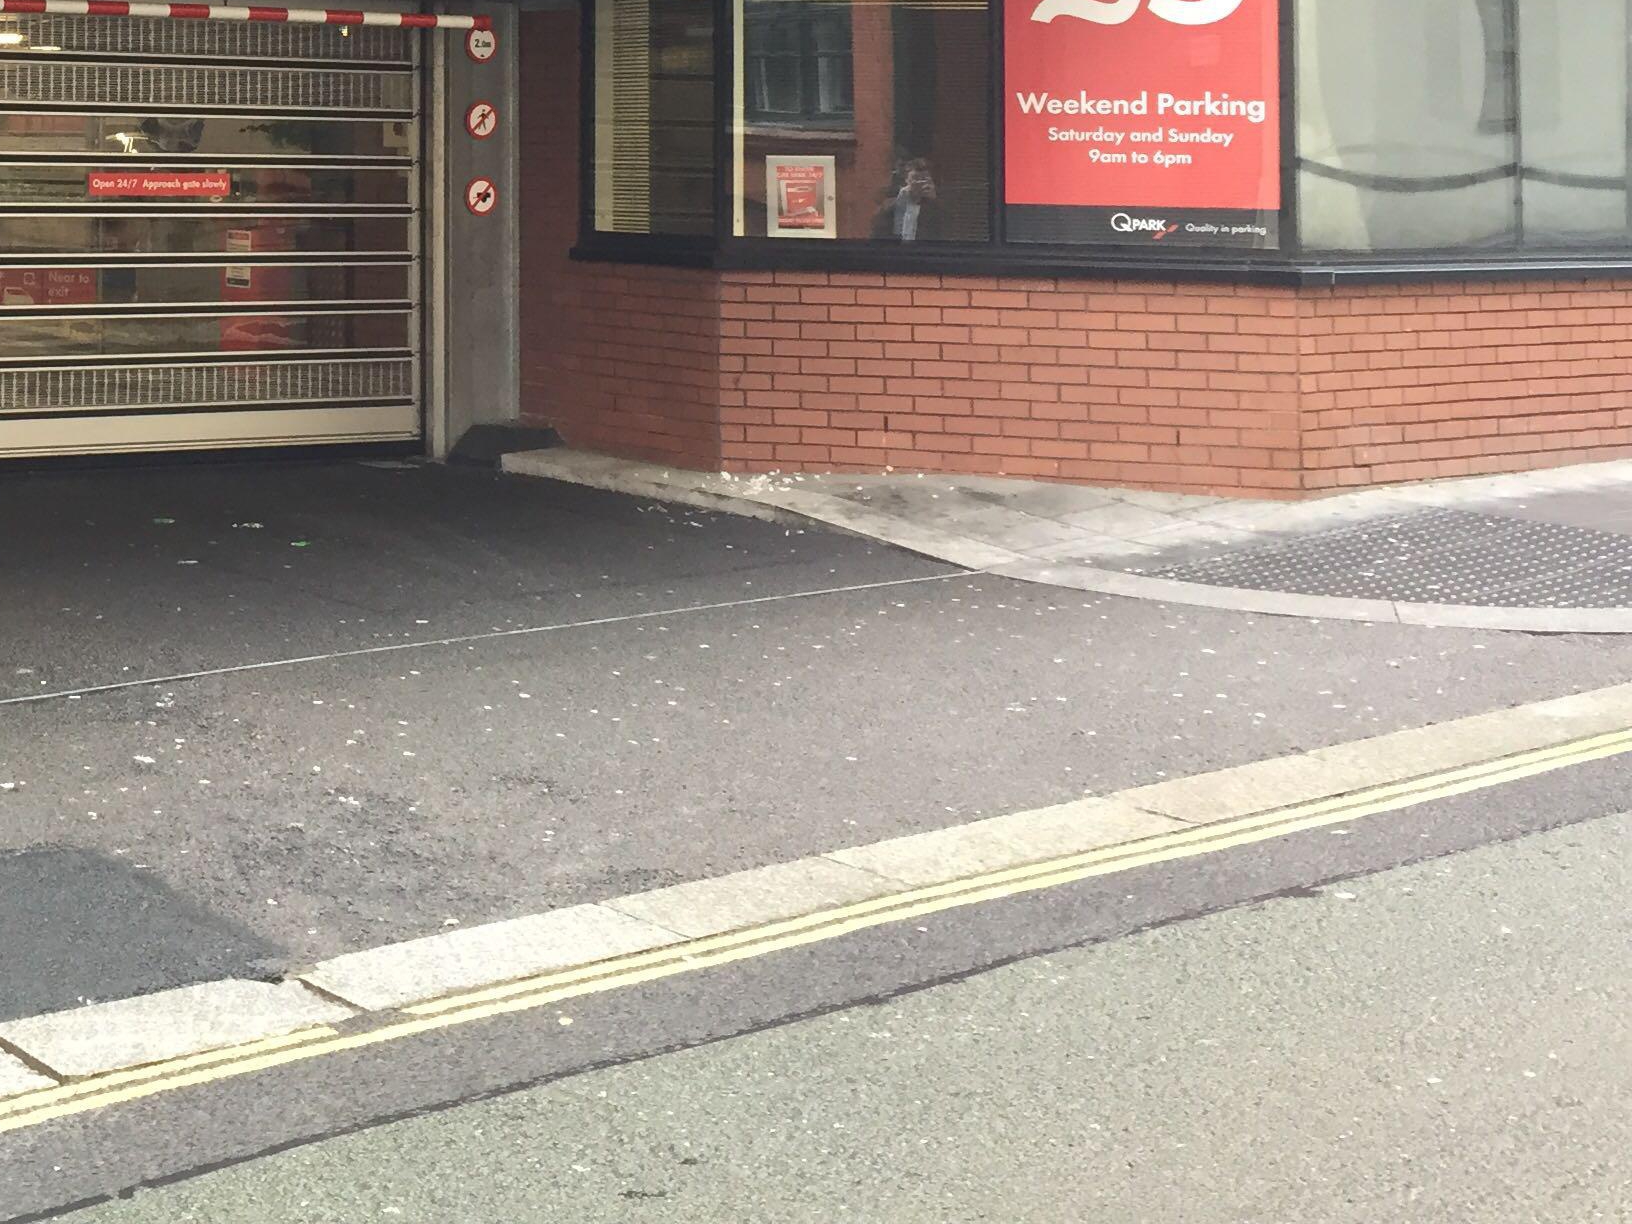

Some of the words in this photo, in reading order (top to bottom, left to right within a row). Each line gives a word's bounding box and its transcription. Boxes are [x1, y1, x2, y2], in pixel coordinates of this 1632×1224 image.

[1017, 91, 1147, 115] Weekend
[1157, 92, 1265, 123] Parking
[1048, 127, 1125, 145] Saturday
[1130, 128, 1163, 143] and
[1168, 128, 1233, 147] Sunday
[1088, 149, 1127, 164] 9am
[1131, 151, 1148, 164] to
[1153, 150, 1192, 168] 6pm
[92, 178, 115, 190] Open
[117, 178, 137, 189] 24/7
[143, 178, 180, 190] Approach
[182, 180, 200, 191] gate
[202, 178, 227, 191] slowly
[1185, 223, 1218, 235] Quality
[1221, 224, 1229, 233] in
[1231, 224, 1267, 236] parking
